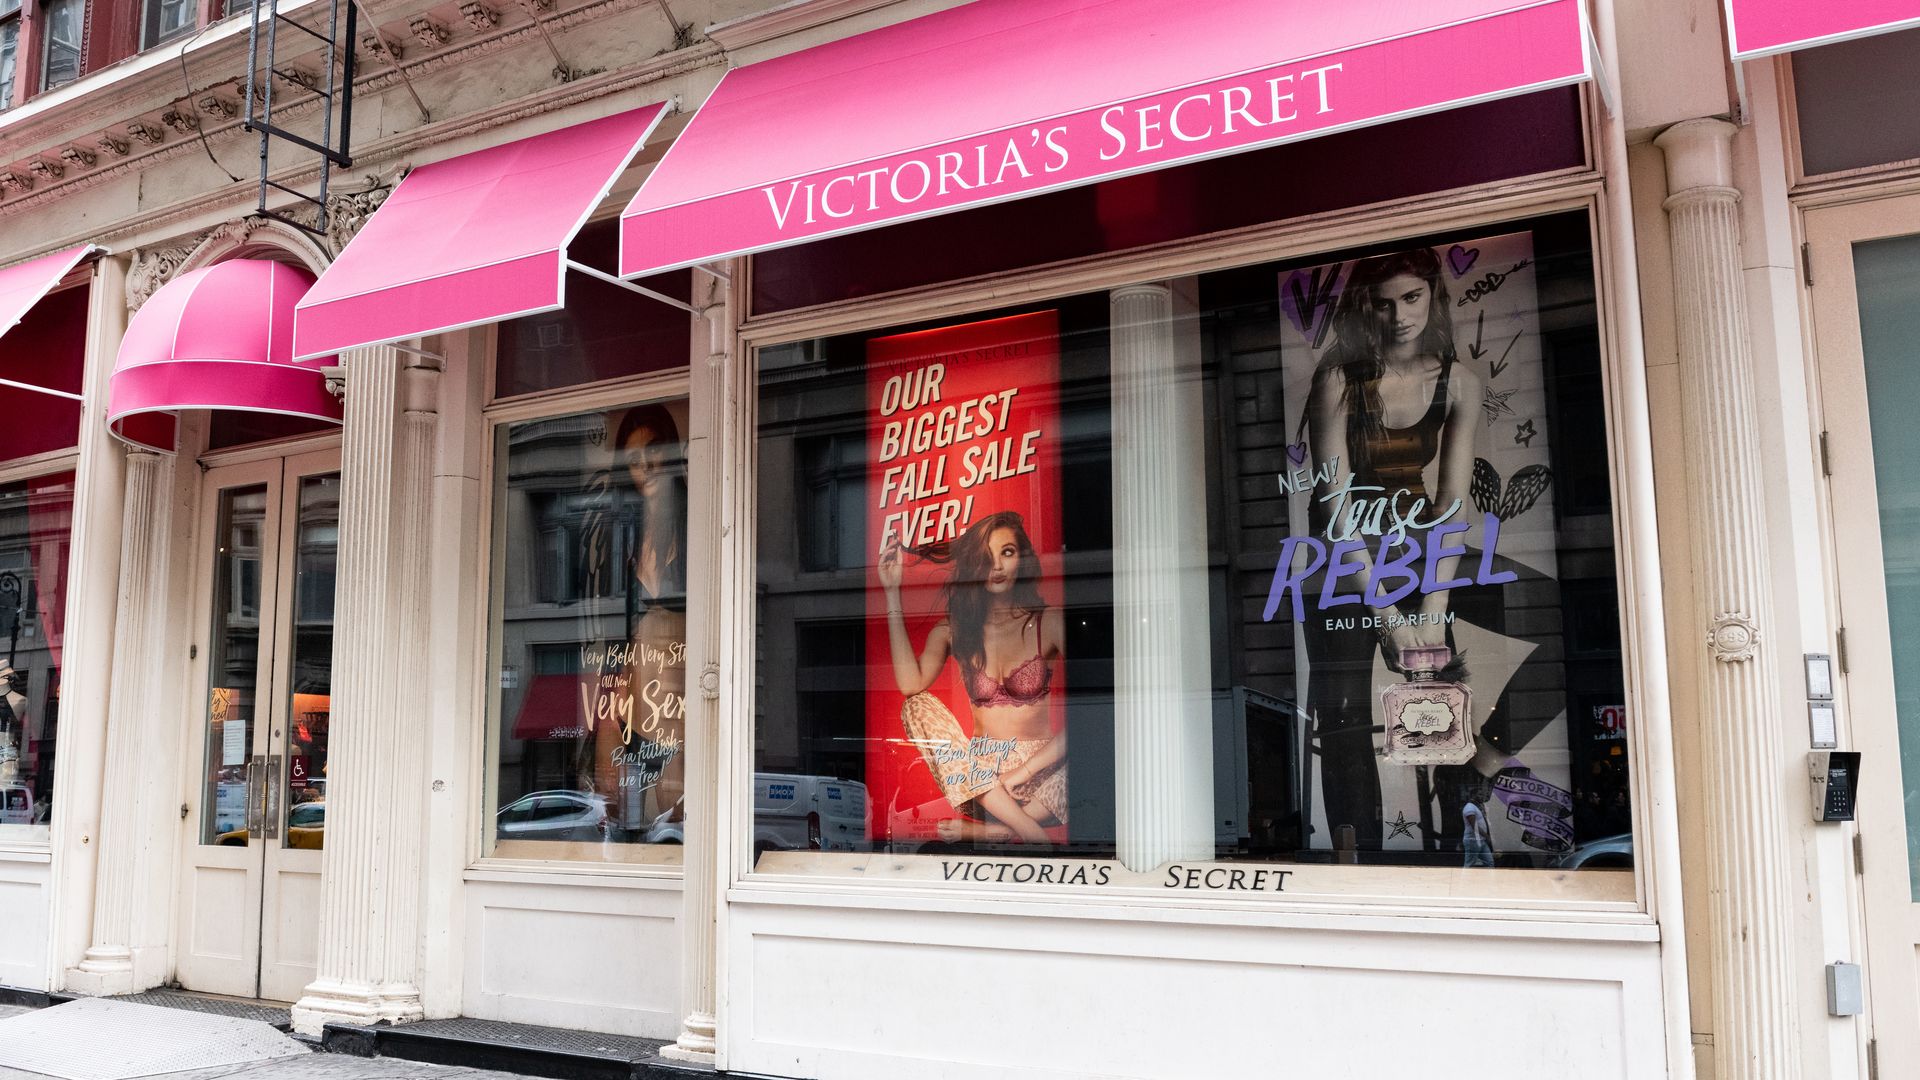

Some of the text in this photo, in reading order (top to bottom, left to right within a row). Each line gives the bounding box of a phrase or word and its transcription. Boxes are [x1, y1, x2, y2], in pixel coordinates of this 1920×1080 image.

[762, 63, 1344, 231] VICTORIA'S SECRET
[880, 363, 945, 417] OUR
[879, 388, 1018, 463] BIGGEST
[879, 429, 1041, 509] FALL SALE
[1277, 456, 1340, 495] NEW!
[879, 495, 974, 556] EVER!
[1262, 512, 1519, 623] REBEL
[1325, 612, 1456, 631] EAU DE PARFUM
[580, 646, 604, 676] Very
[606, 642, 638, 667] Bold,
[640, 643, 665, 674] Very
[615, 673, 632, 688] New!
[581, 682, 634, 745] Very
[611, 739, 680, 767] Bra fittings
[936, 734, 1017, 764] Bra fittings
[619, 760, 665, 788] are free!
[946, 756, 1000, 786] are free!
[1497, 776, 1571, 806] VICTORIA'S
[1511, 807, 1574, 841] SECRET
[941, 861, 1293, 892] VICTORIA'S SECRET
